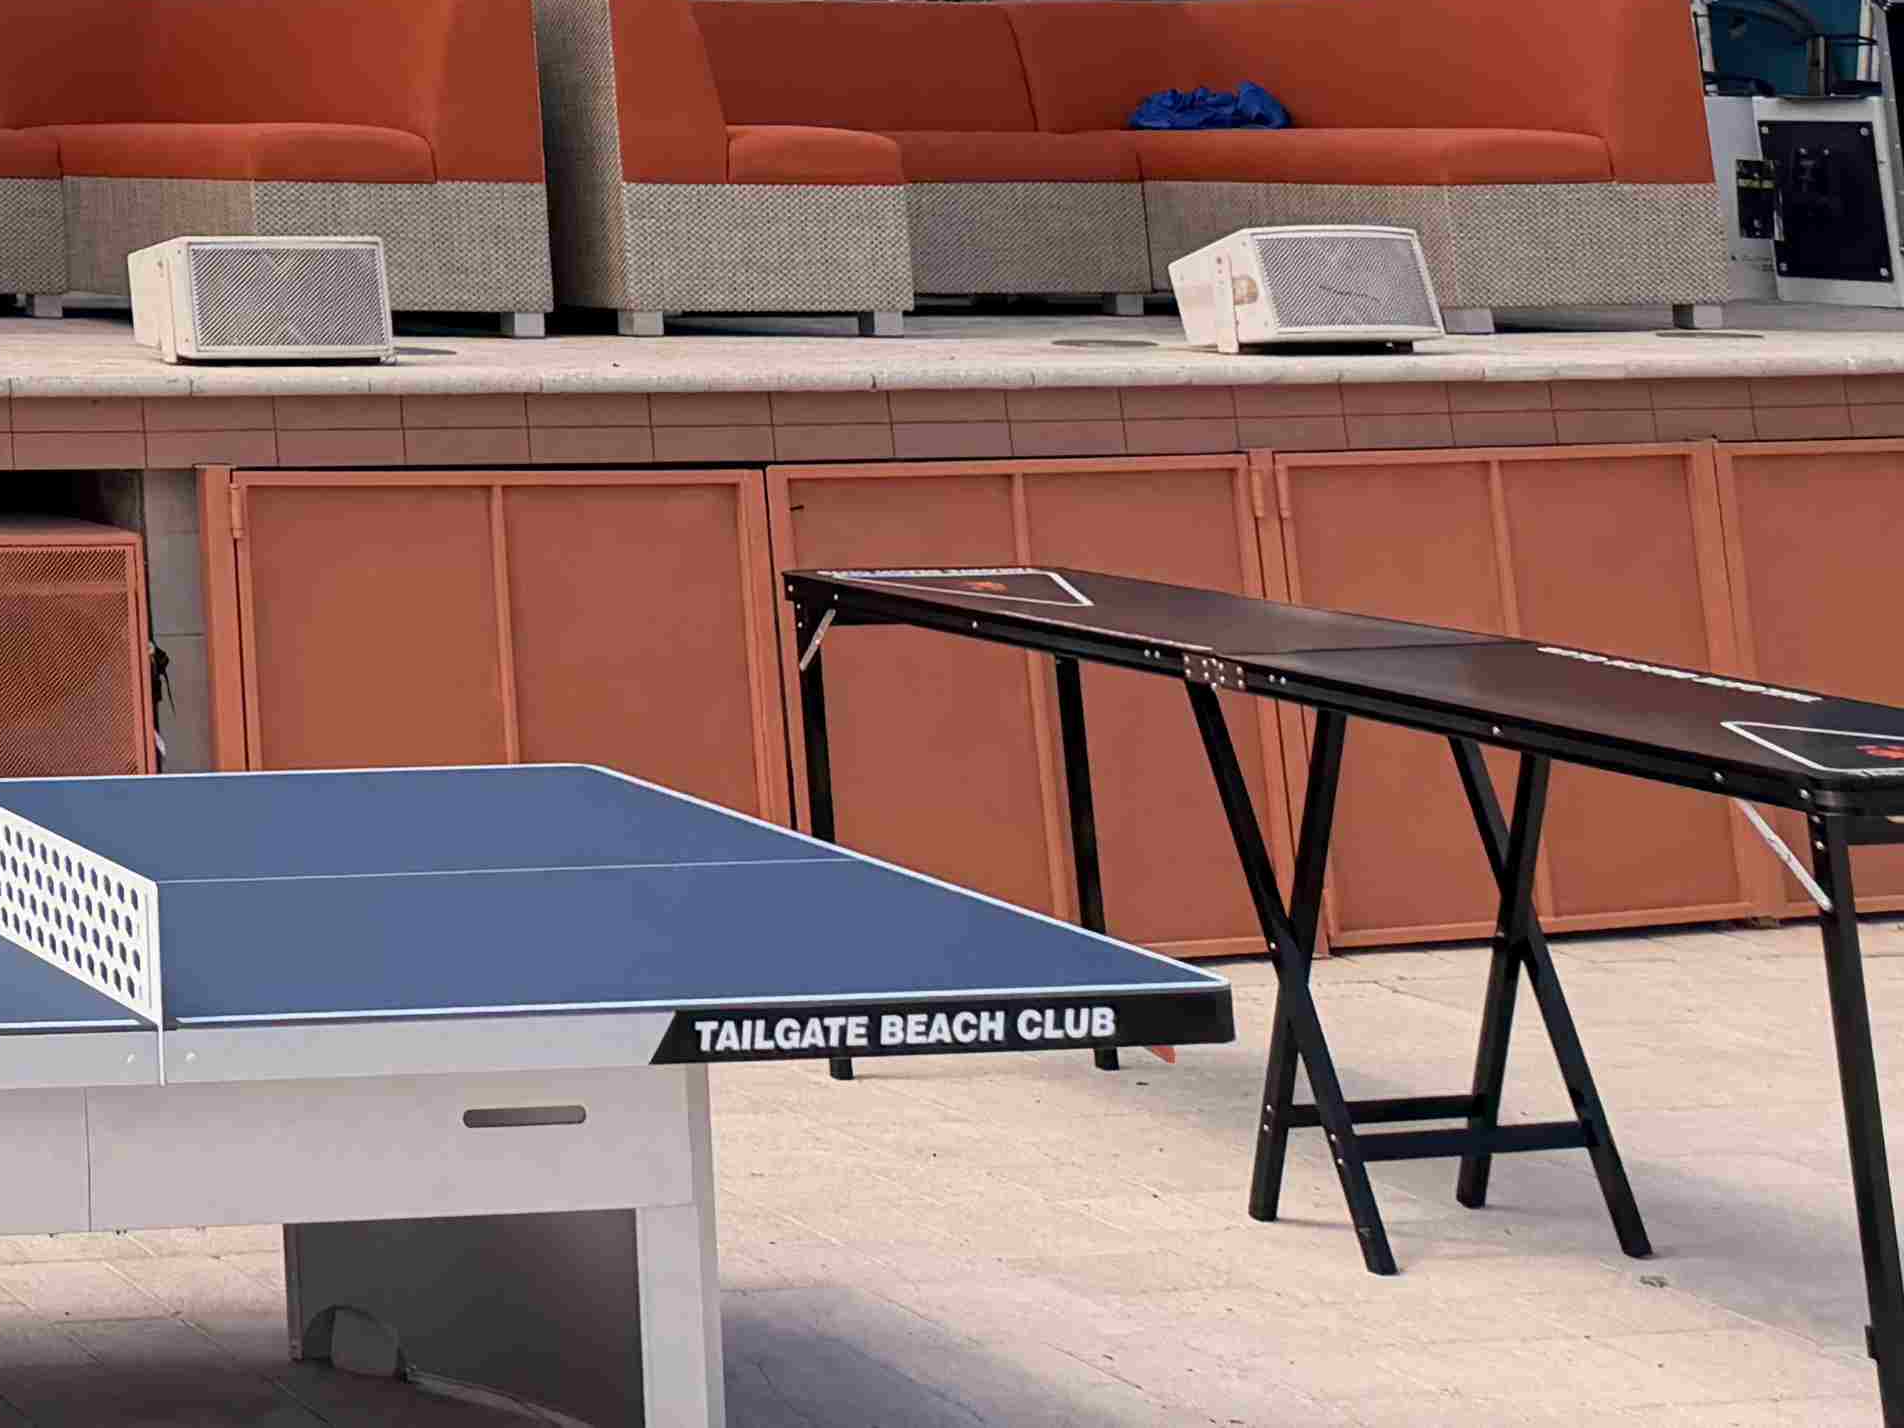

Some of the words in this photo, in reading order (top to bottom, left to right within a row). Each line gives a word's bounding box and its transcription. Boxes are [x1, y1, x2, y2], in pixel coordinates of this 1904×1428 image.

[694, 1015, 870, 1053] TAILGATE
[879, 1010, 1007, 1046] BEACH
[1016, 1006, 1116, 1041] CLUB
